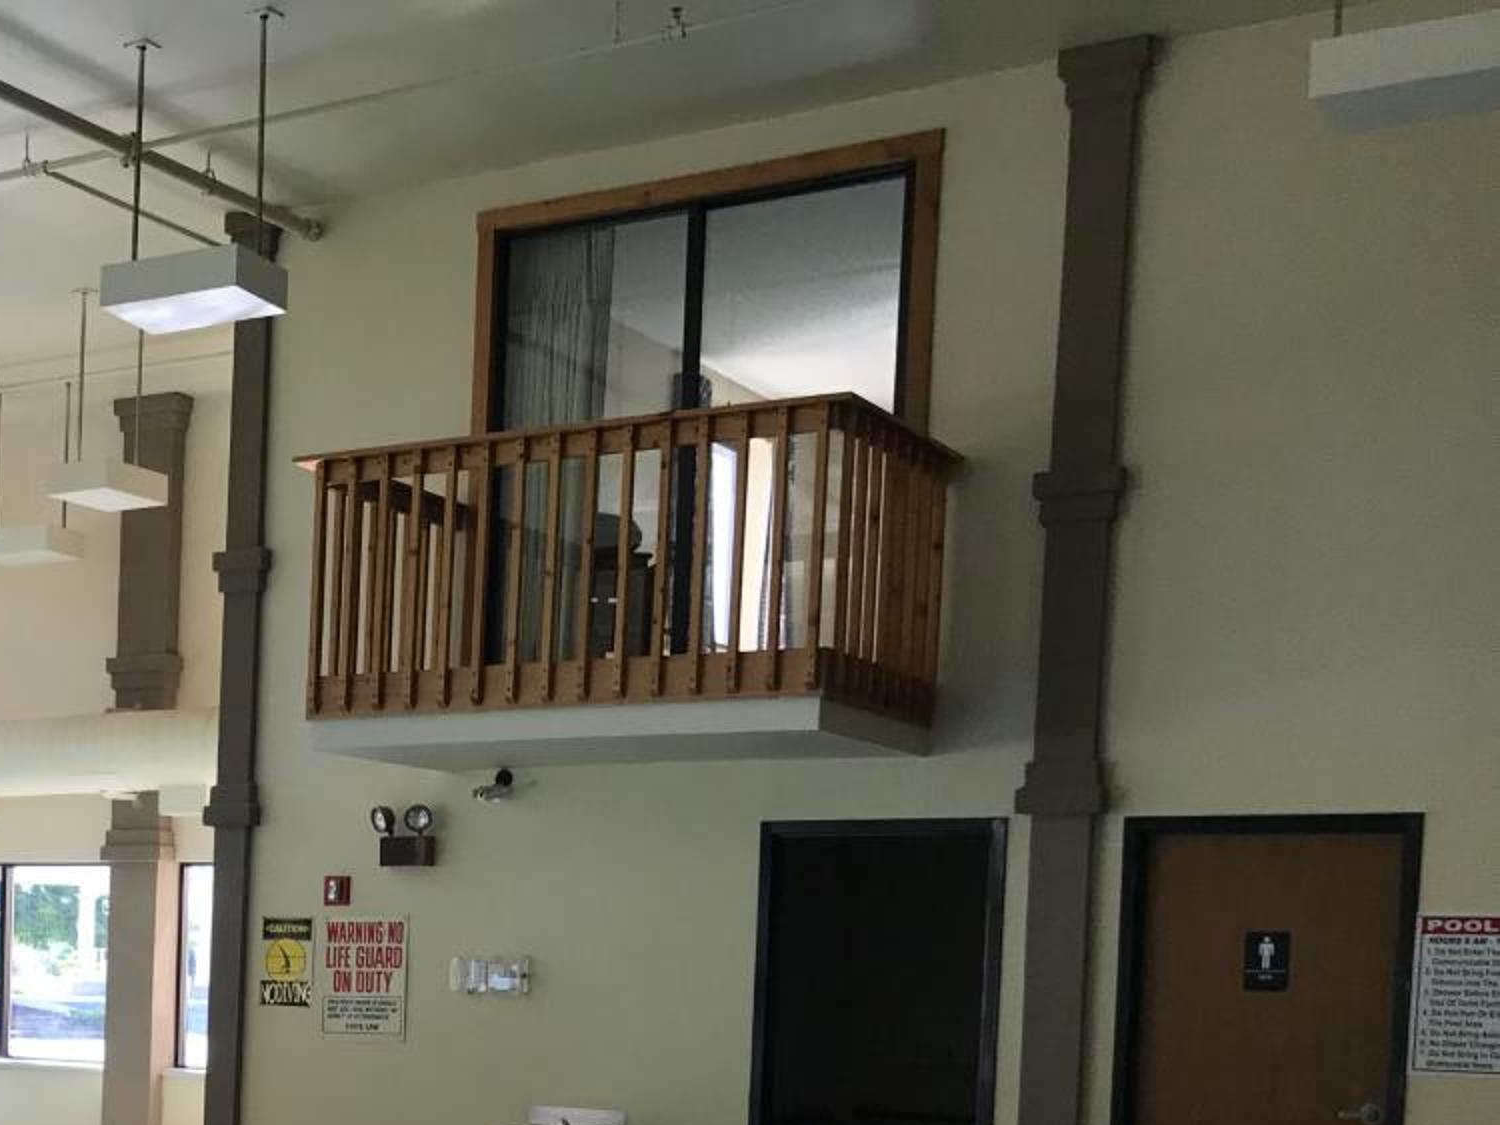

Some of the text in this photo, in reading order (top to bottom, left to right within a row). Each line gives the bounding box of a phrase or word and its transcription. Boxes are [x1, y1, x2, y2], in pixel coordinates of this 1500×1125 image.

[326, 921, 404, 944] WARNING NO
[1427, 919, 1499, 933] POOL
[325, 946, 403, 969] LIFE GUARD
[333, 971, 393, 993] ON DUTY
